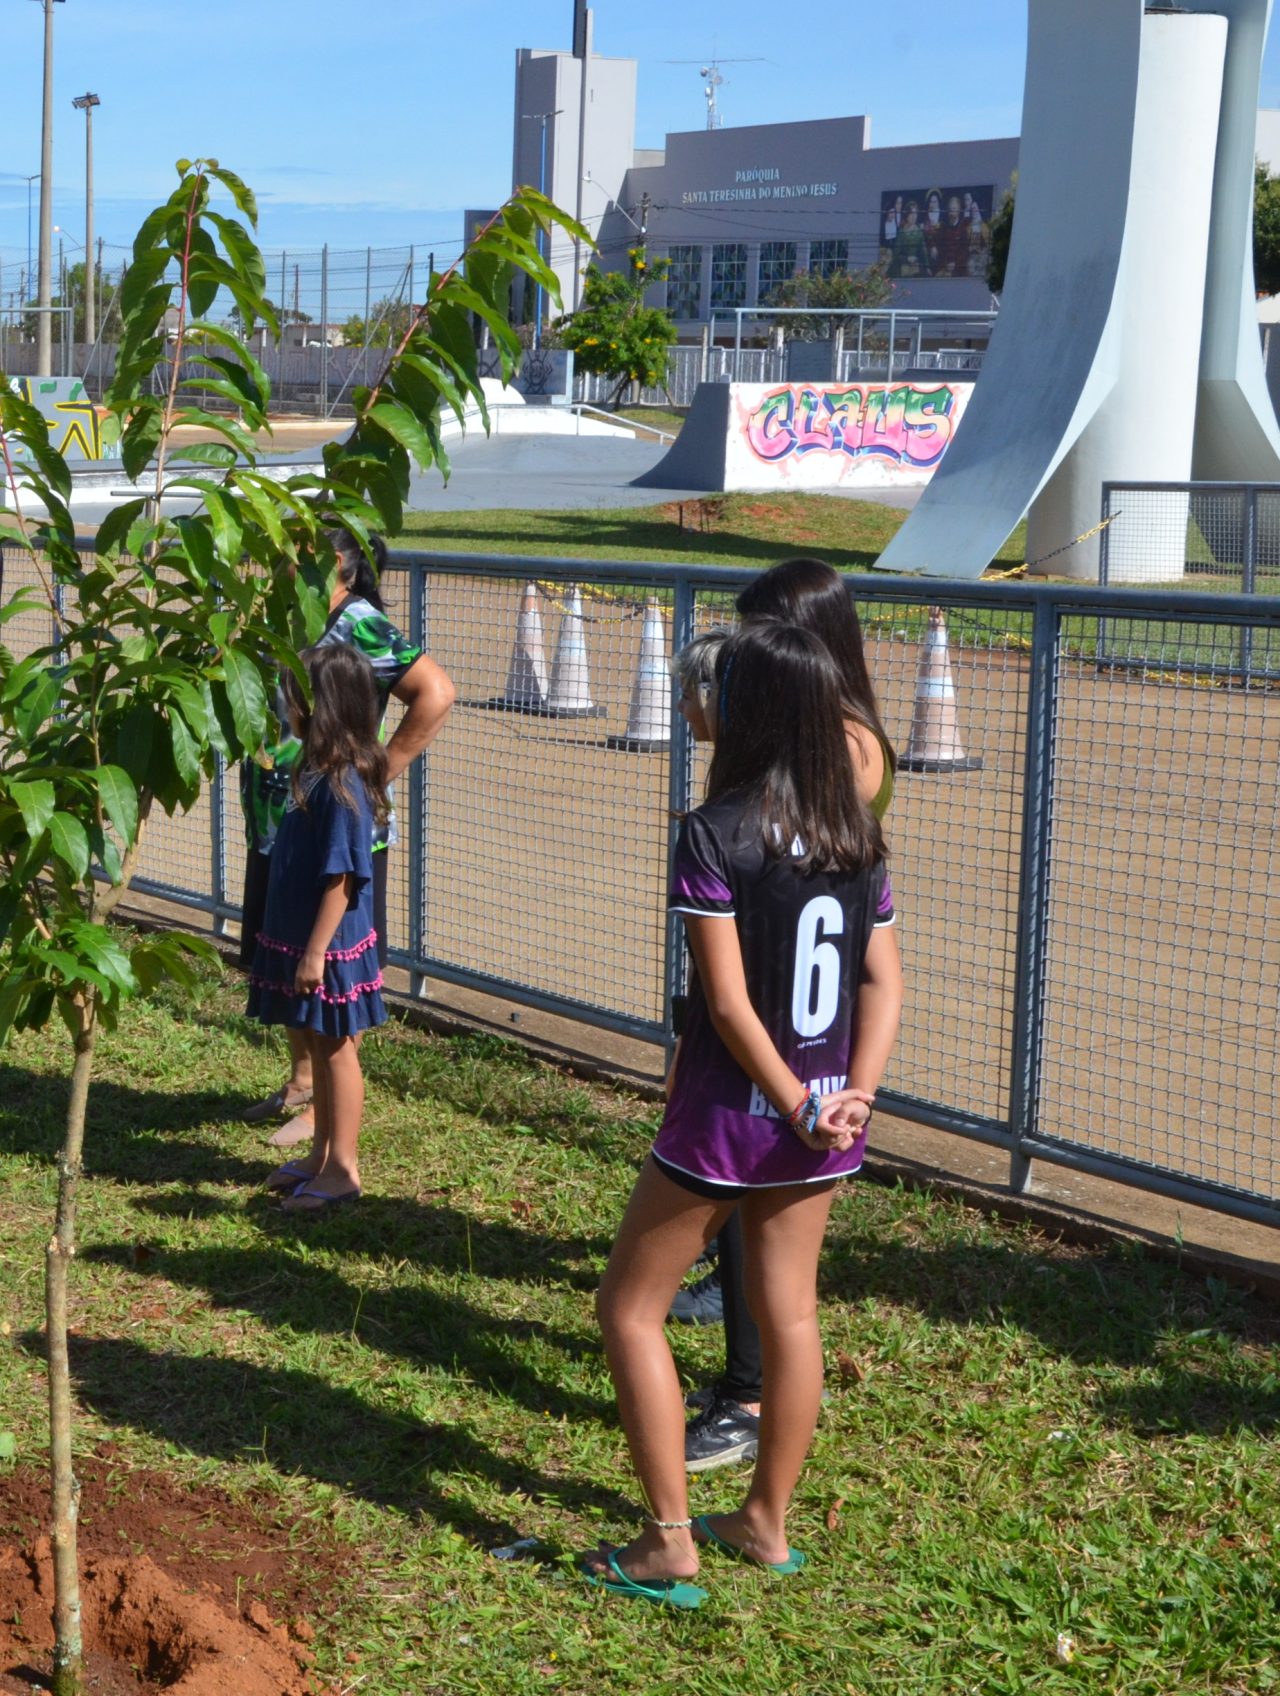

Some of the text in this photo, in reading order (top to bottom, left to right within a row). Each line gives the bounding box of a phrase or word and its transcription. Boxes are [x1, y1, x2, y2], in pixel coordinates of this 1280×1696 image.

[735, 167, 780, 183] PARÓQUIA
[682, 191, 708, 204] SANTA
[709, 187, 757, 203] TERESINHA
[759, 186, 771, 199] DO
[773, 184, 808, 199] MENINO
[791, 895, 844, 1038] 6
